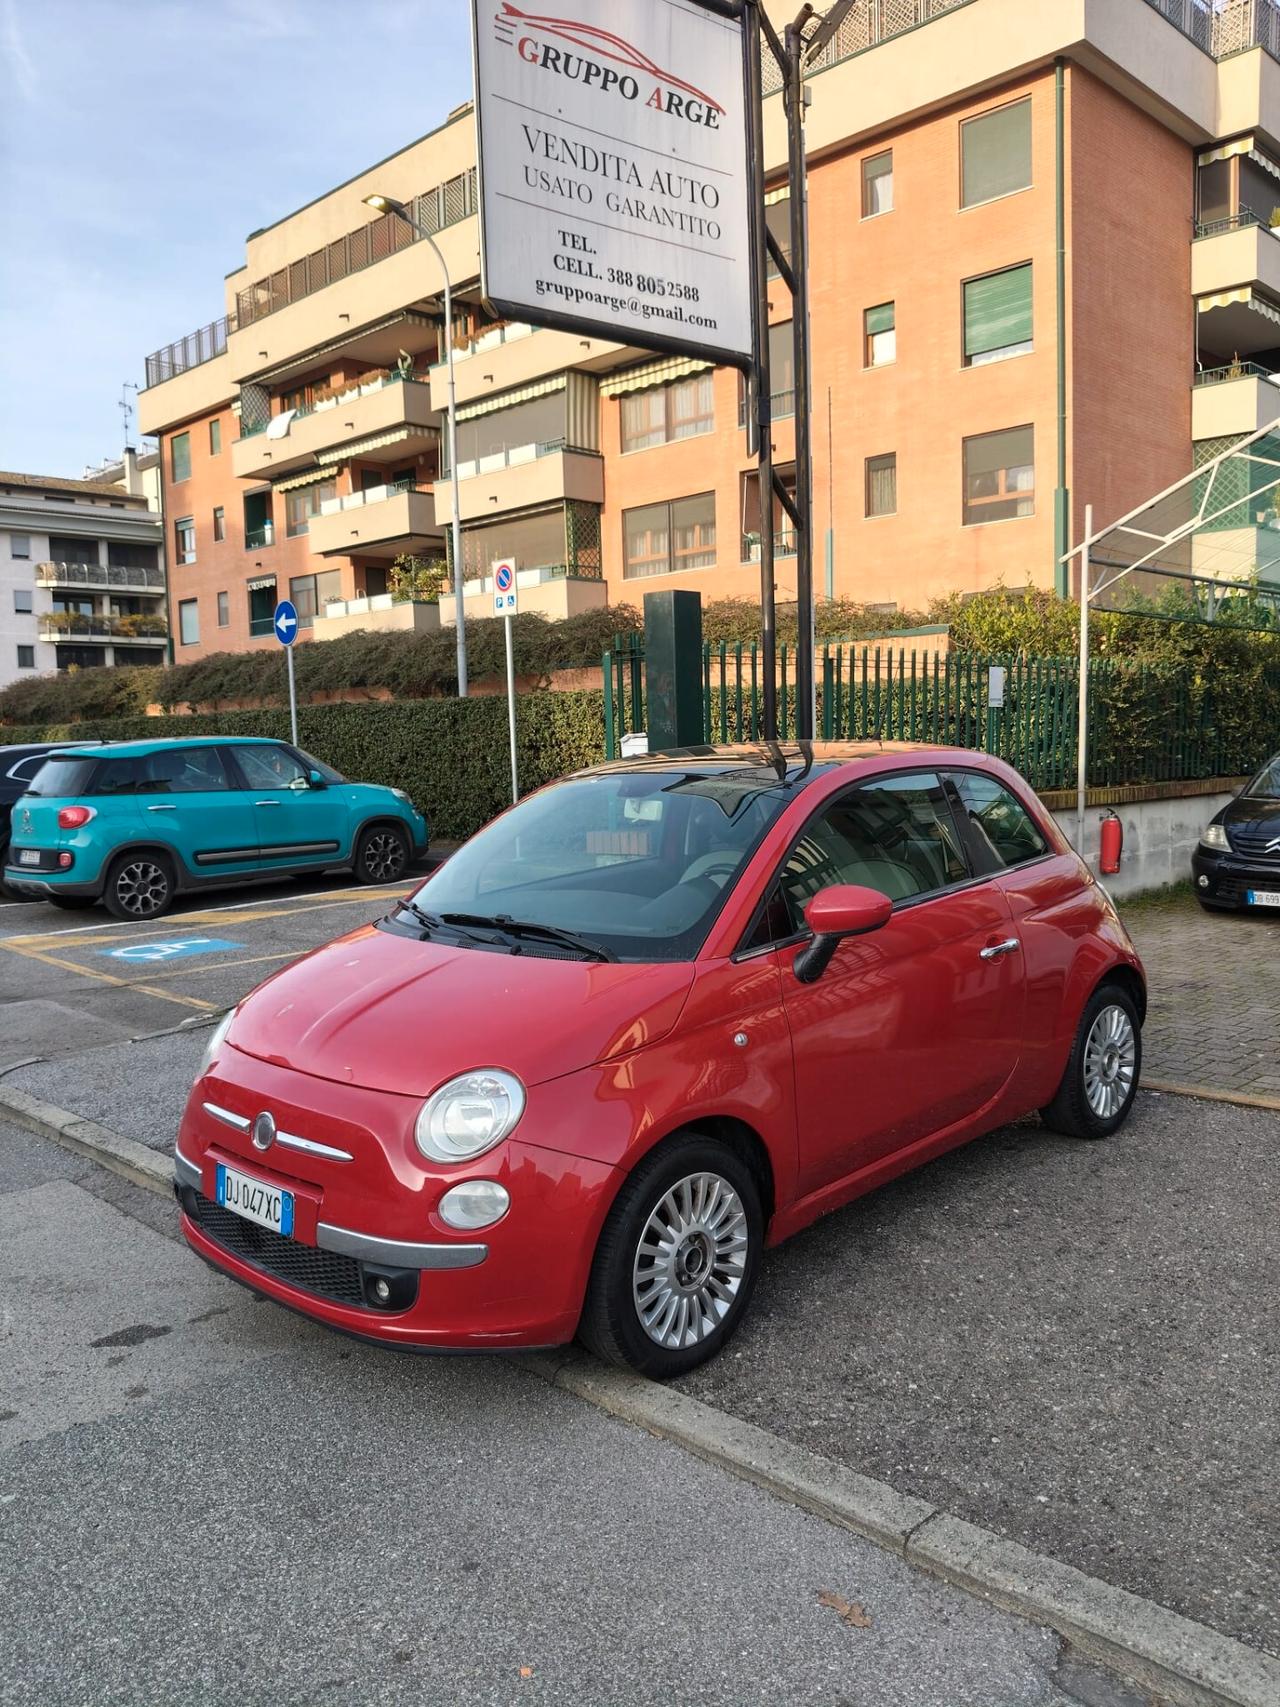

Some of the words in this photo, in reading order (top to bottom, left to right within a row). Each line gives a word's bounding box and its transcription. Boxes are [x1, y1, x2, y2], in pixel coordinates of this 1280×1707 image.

[517, 36, 639, 100] GRUPPO
[645, 87, 720, 129] ARGE
[521, 124, 643, 188] VENDITA
[649, 169, 719, 209] AUTO
[523, 165, 593, 204] USATO
[606, 192, 721, 240] GARANTITO
[553, 254, 603, 280] CELL.
[558, 230, 597, 254] TEL.
[535, 278, 718, 330] gruppoarge@gmail.com
